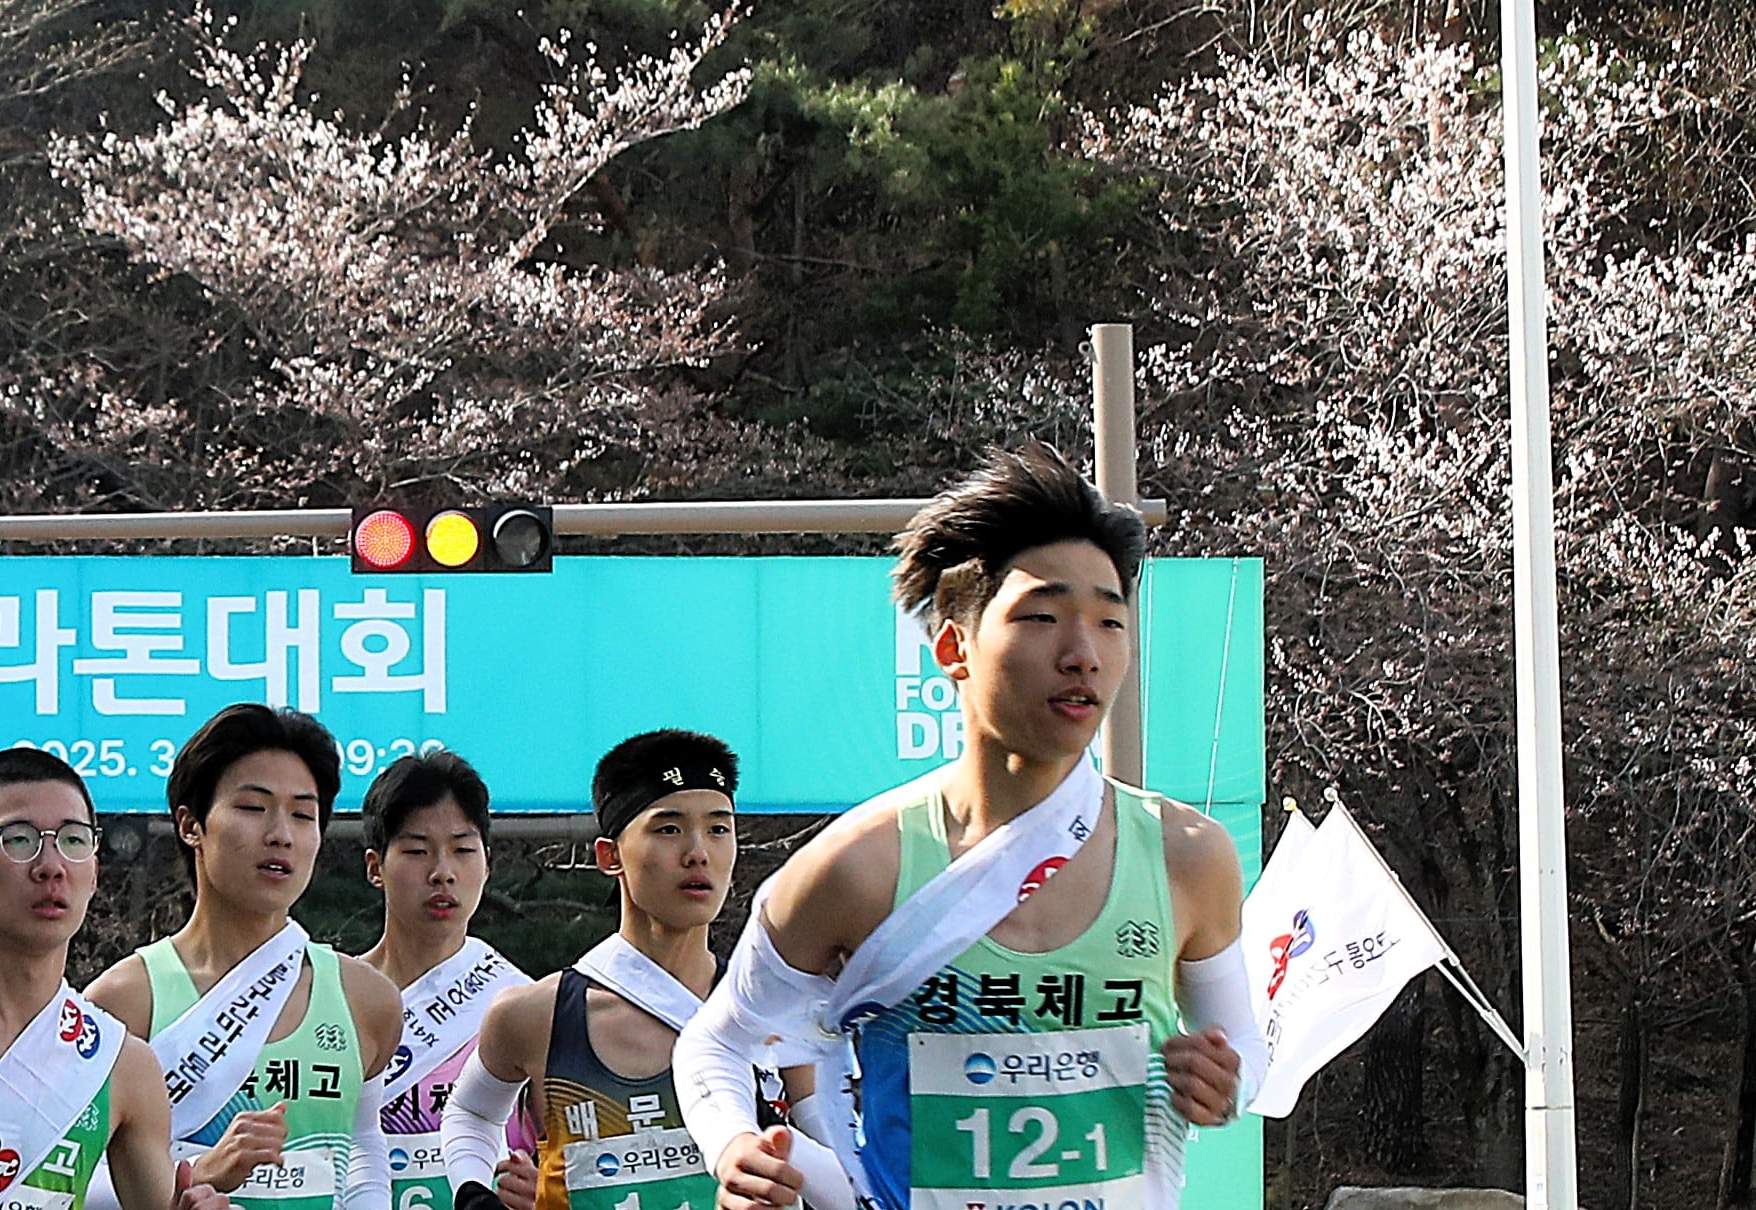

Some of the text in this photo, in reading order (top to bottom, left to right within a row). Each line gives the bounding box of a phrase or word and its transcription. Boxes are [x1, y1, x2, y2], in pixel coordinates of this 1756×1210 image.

[896, 677, 960, 711] FO
[1000, 1050, 1101, 1085] 우리은행
[623, 1143, 701, 1174] 우리은행
[955, 1106, 1108, 1180] 12-1
